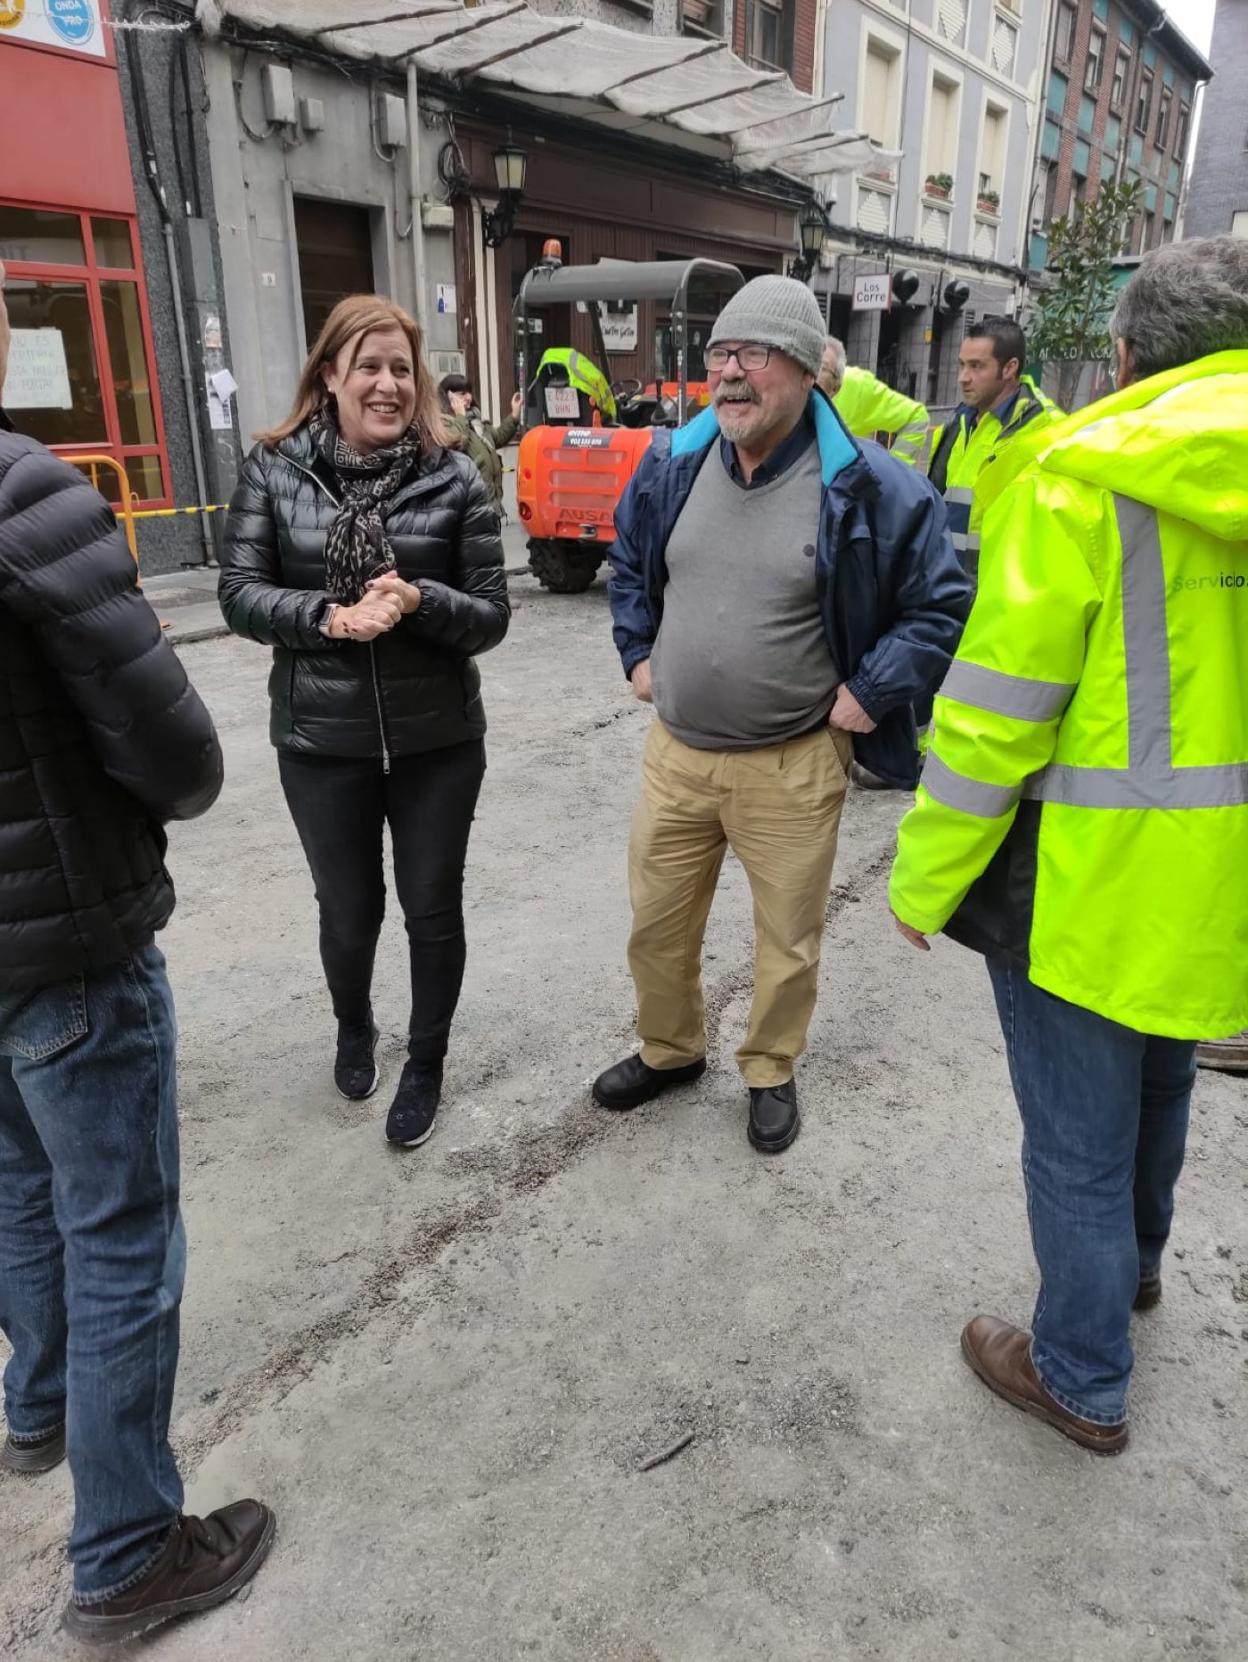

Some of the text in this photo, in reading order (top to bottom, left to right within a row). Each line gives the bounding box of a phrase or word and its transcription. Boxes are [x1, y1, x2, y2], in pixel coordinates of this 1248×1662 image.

[864, 281, 880, 292] Los
[559, 508, 611, 522] AUSA
[1172, 571, 1248, 592] Servicio
